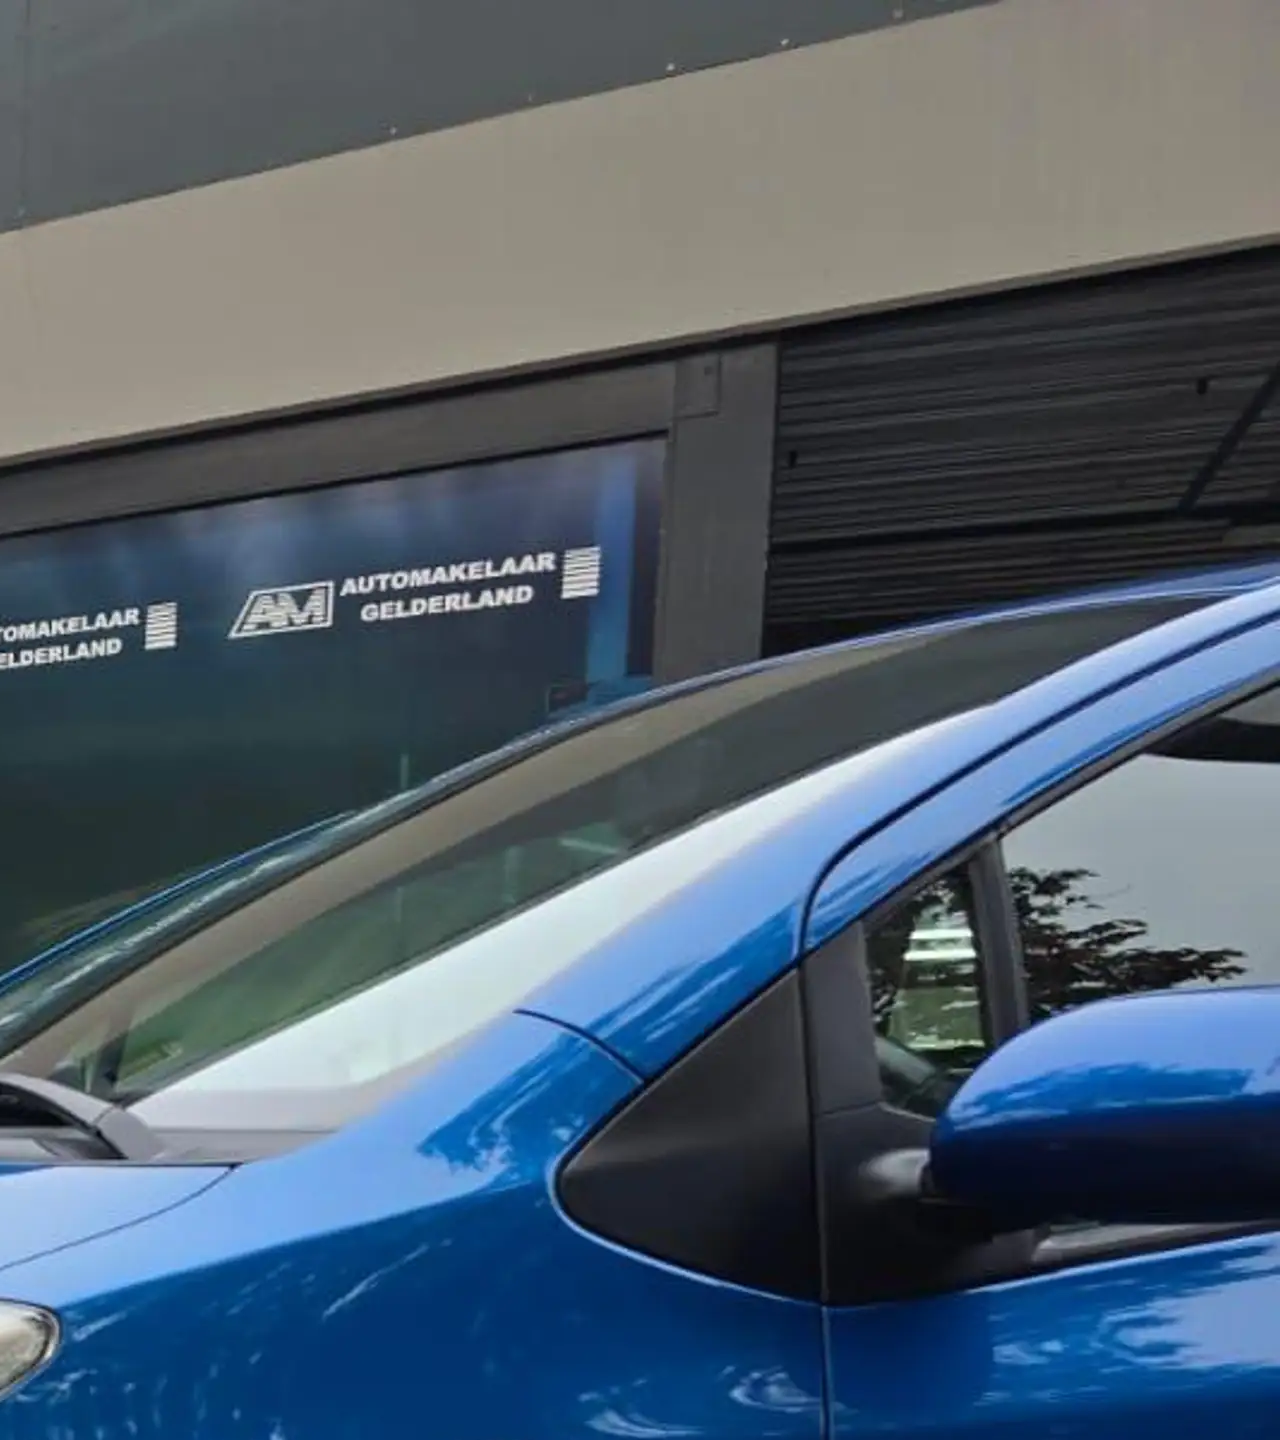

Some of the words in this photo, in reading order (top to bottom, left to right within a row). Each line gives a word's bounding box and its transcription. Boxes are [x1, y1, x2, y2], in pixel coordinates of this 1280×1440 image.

[340, 551, 557, 597] AUTOMAKELAAR
[242, 586, 326, 631] AM
[360, 584, 534, 623] GELDERLAND
